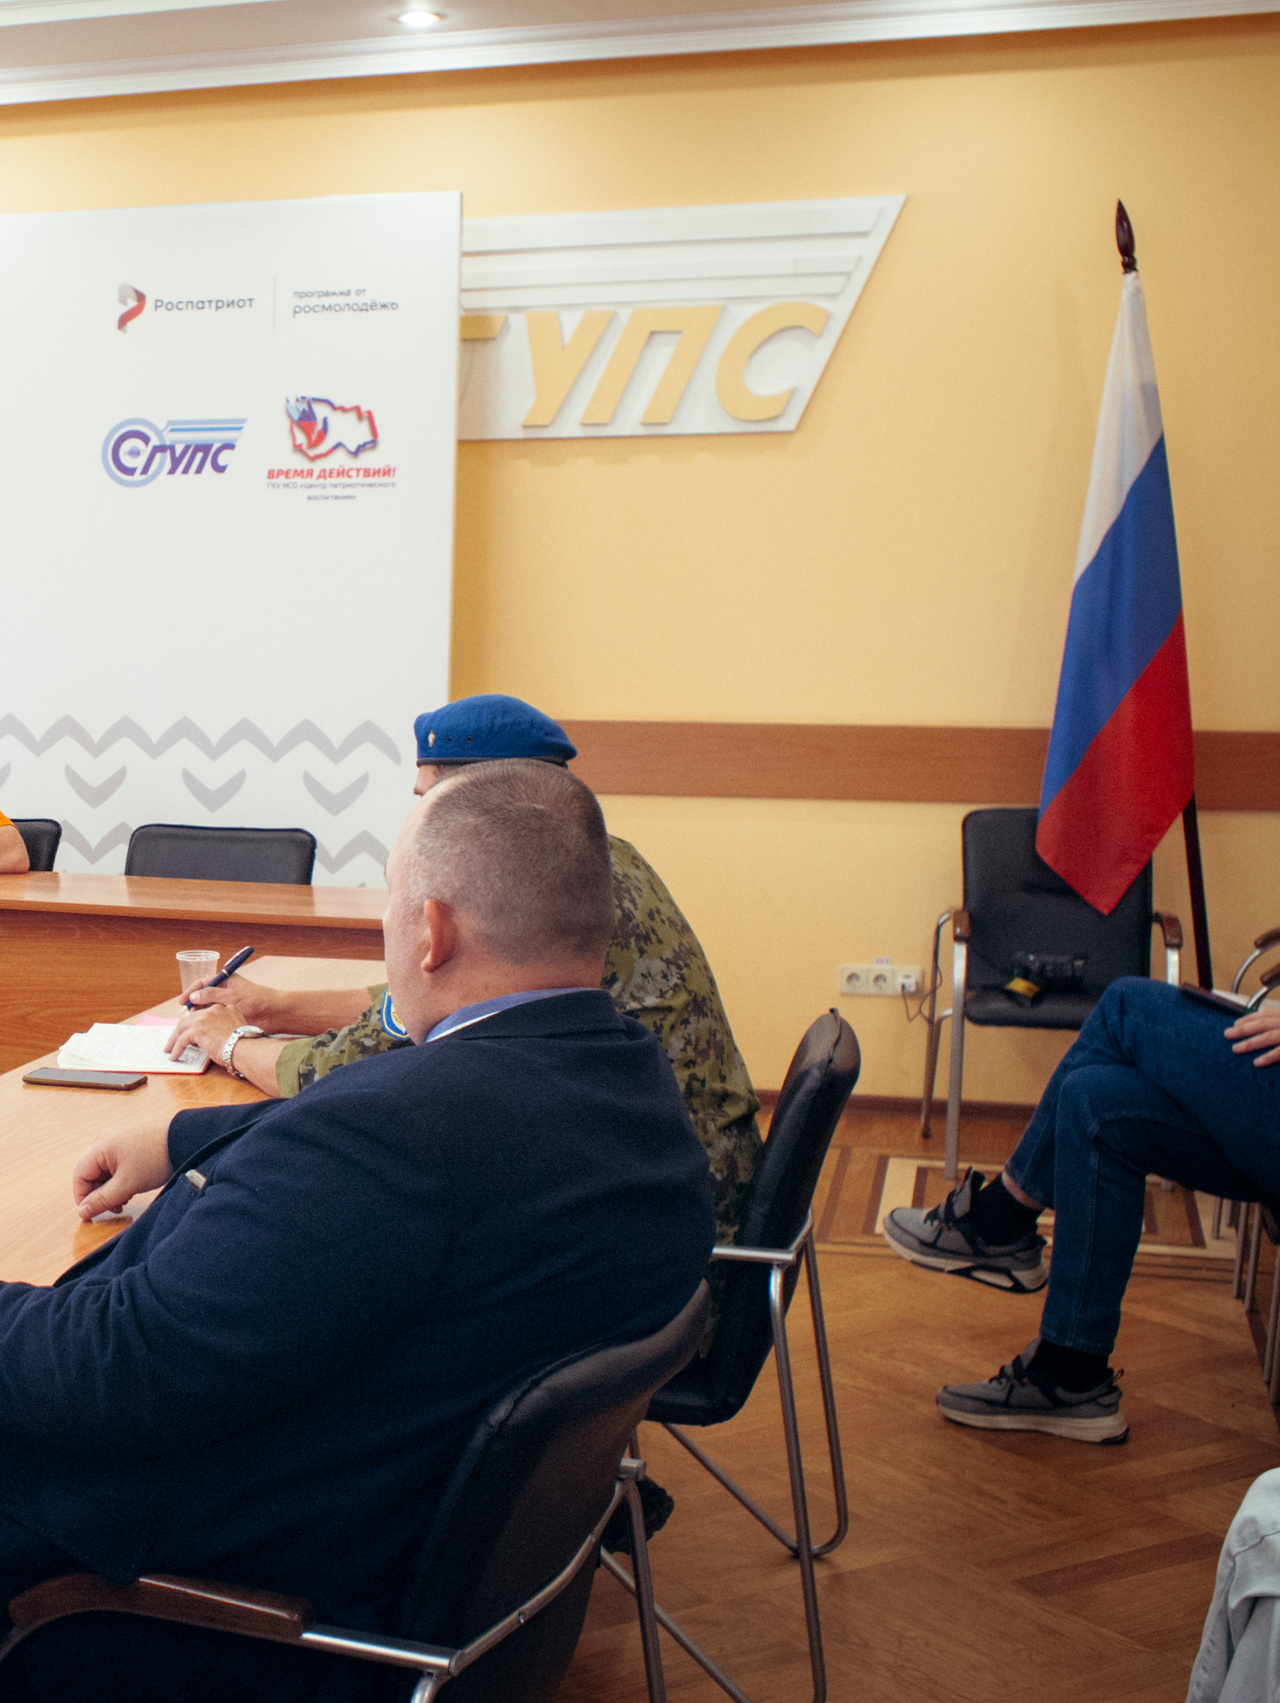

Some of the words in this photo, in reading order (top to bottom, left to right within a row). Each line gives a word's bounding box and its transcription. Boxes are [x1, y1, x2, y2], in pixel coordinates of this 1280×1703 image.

[293, 289, 351, 299] программа
[355, 288, 366, 296] от
[154, 297, 255, 312] Роспатриот
[111, 429, 236, 477] СГУПС
[267, 468, 314, 480] ВРЕМЯ
[317, 465, 396, 480] ДЕЙСТВИЙ!
